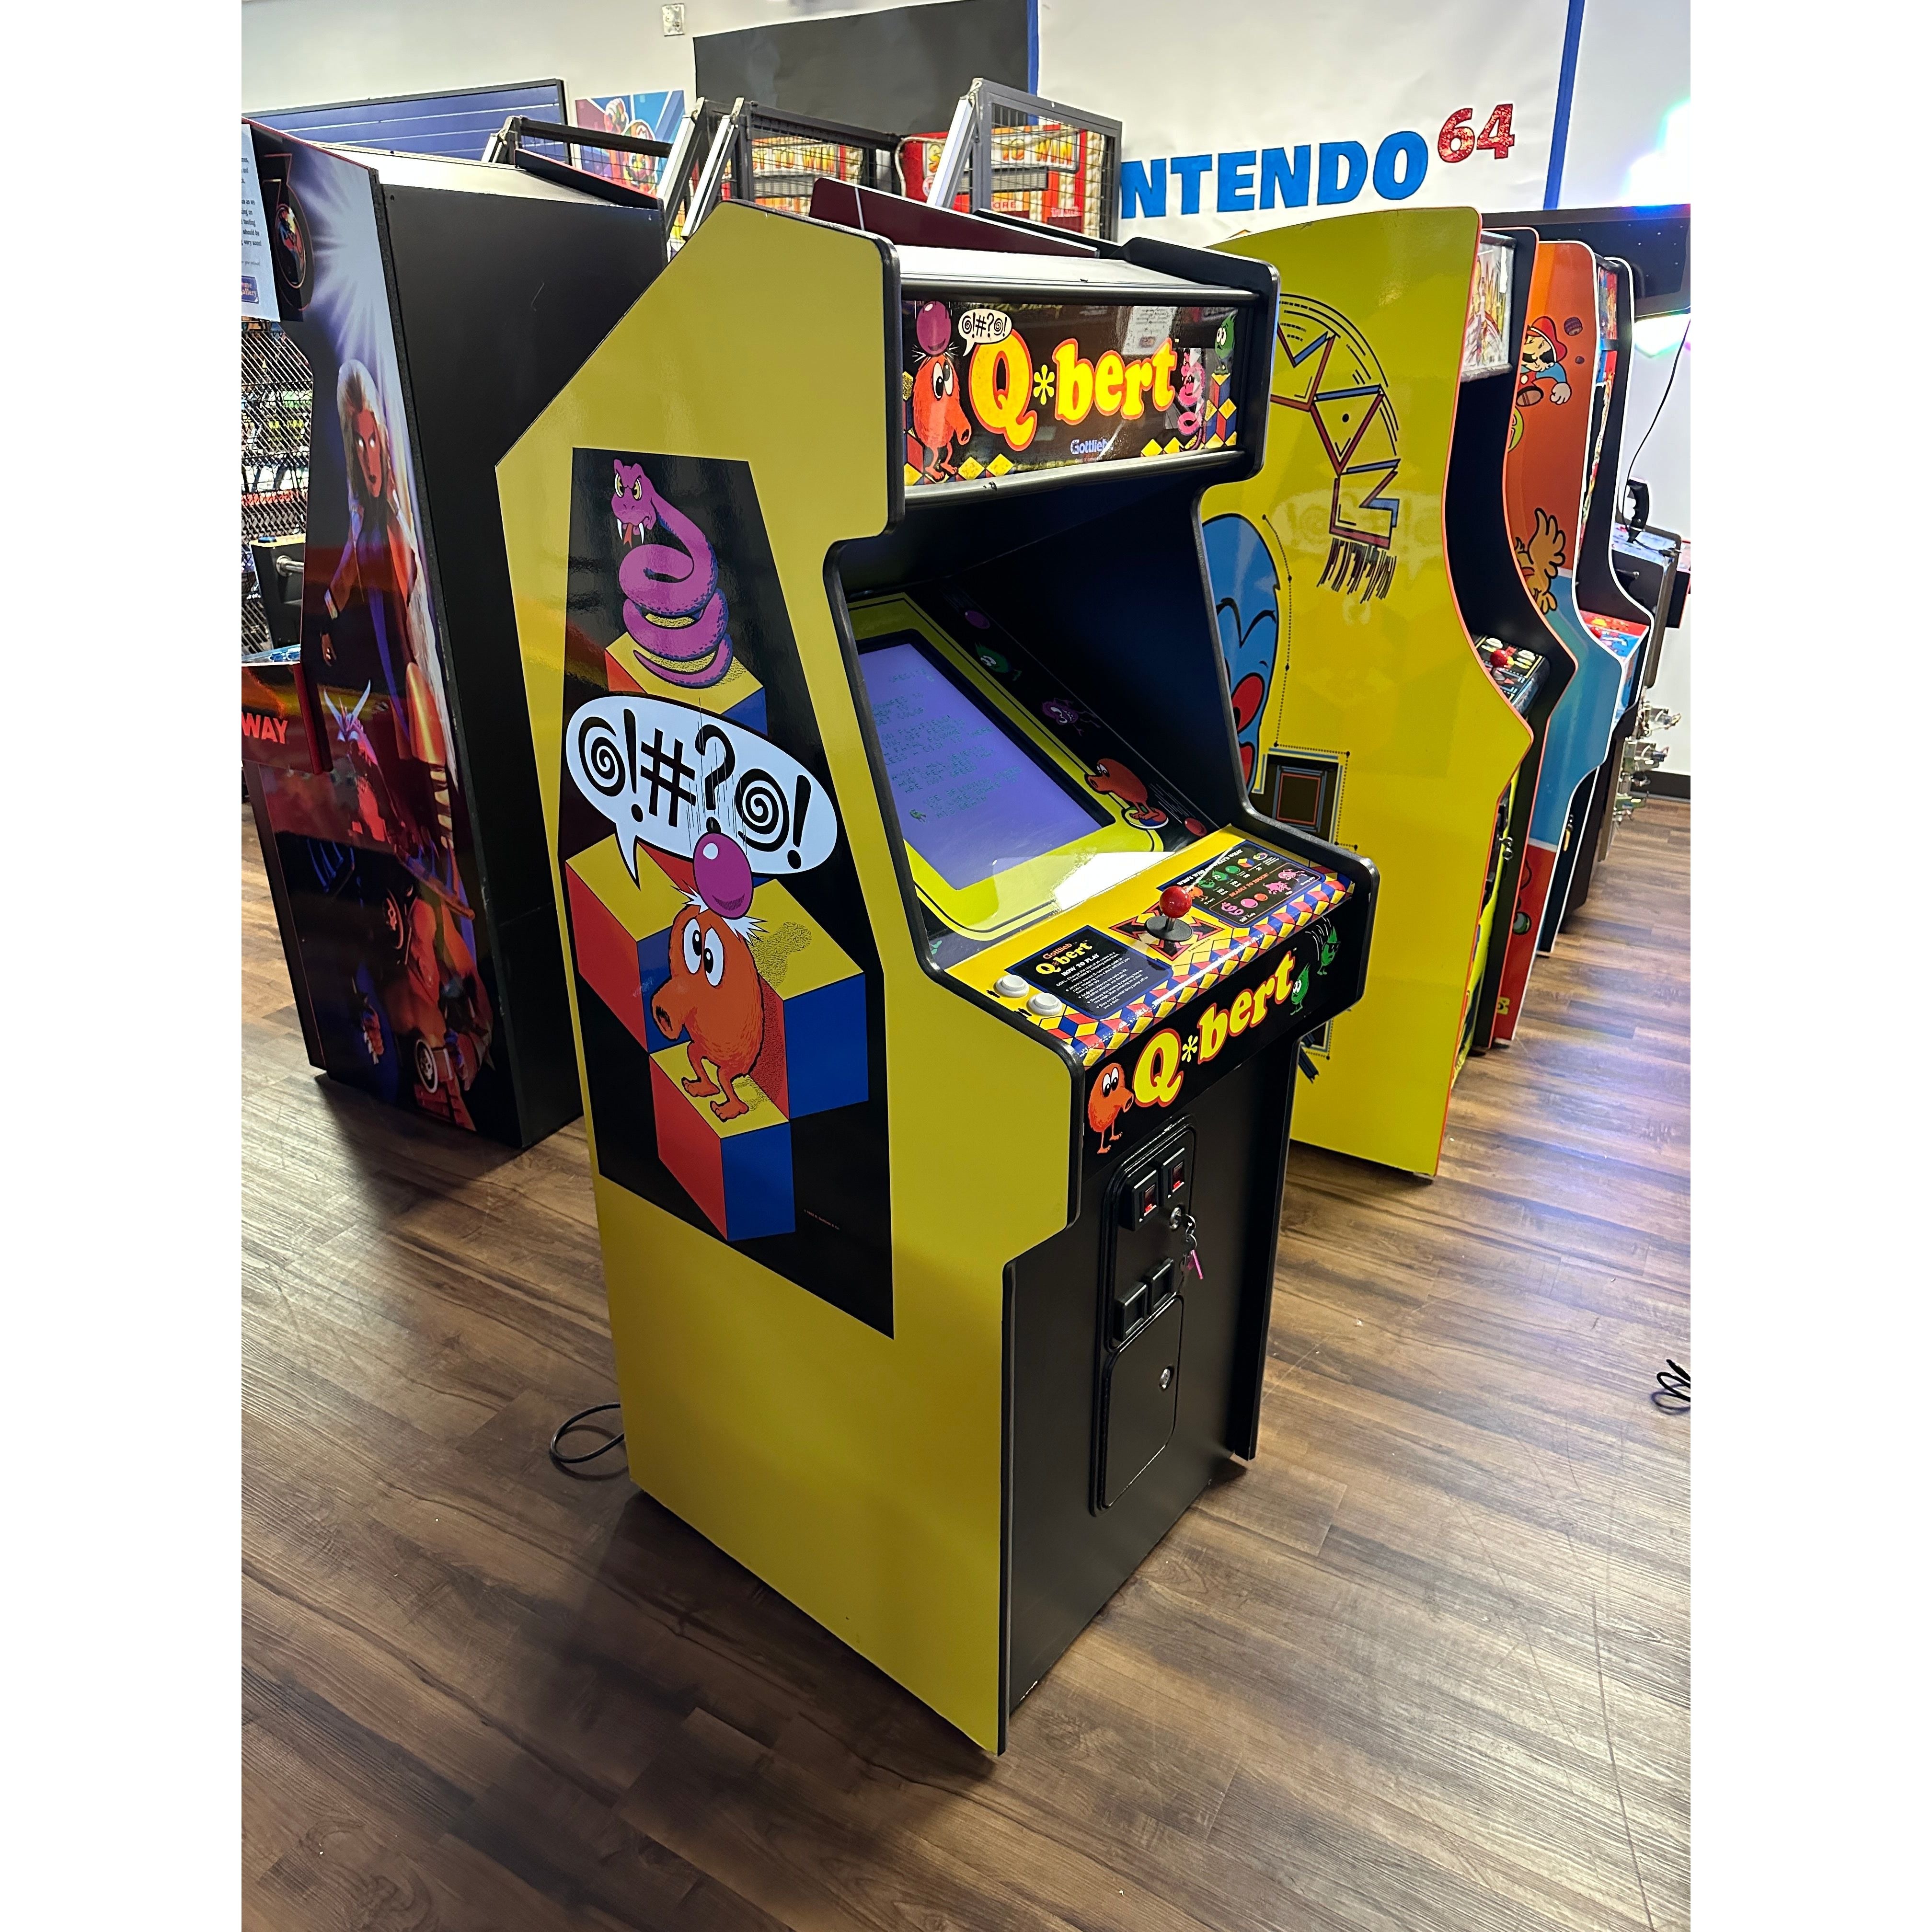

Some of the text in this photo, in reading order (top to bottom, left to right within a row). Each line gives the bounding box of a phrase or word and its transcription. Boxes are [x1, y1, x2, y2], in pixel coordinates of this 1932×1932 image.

[1438, 103, 1515, 163] 64
[242, 712, 288, 744] WAY
[1176, 876, 1194, 886] WHO'S
[1228, 849, 1243, 858] WHAT
[1229, 886, 1247, 897] DEADLY
[1252, 873, 1268, 883] TOUCH!
[1043, 943, 1073, 959] Gottlieb
[1061, 966, 1076, 977] HOW
[1084, 953, 1099, 963] PLAY
